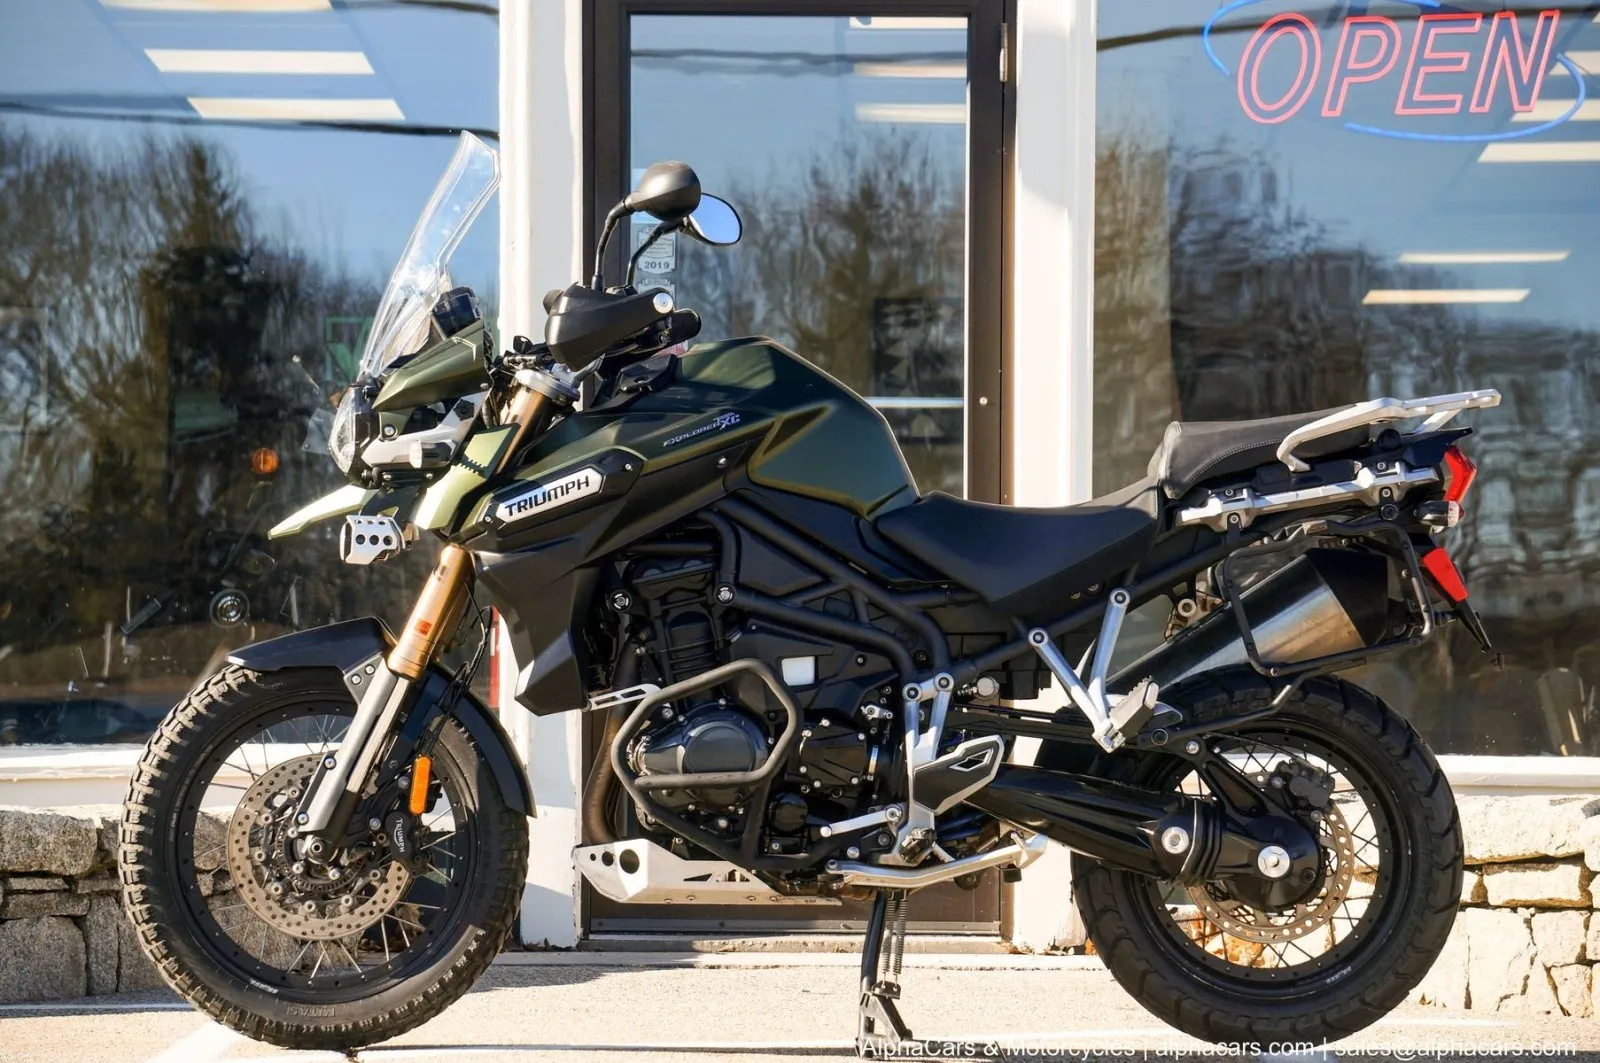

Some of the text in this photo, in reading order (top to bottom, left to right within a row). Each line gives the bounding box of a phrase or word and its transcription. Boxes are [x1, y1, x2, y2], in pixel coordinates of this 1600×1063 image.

[1238, 10, 1560, 124] OPEN
[644, 261, 670, 269] 2019
[504, 475, 590, 516] TRIUMPH
[394, 818, 405, 852] TRIUMPH
